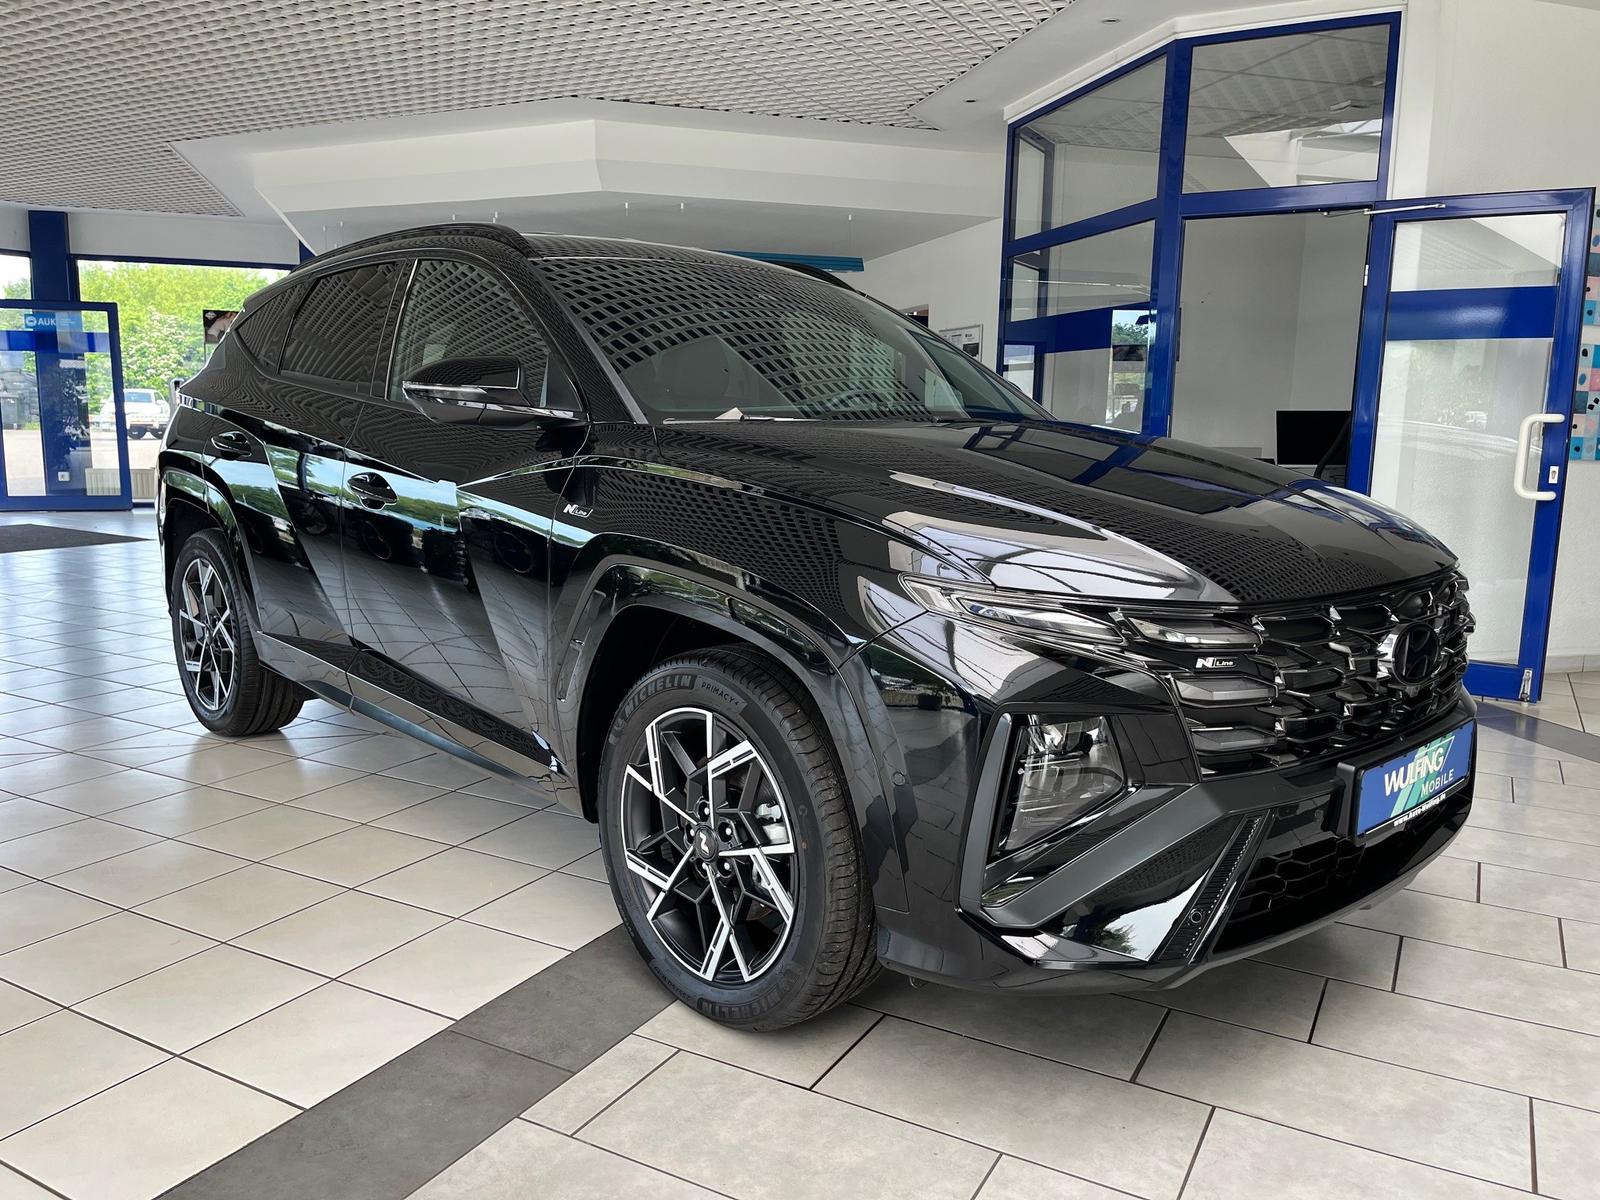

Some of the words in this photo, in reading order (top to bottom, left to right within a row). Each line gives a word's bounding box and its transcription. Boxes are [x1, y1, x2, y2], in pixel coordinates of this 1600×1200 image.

[624, 674, 692, 718] MICHELIN
[701, 682, 734, 704] PRIMACY
[1420, 768, 1454, 798] MOBILE
